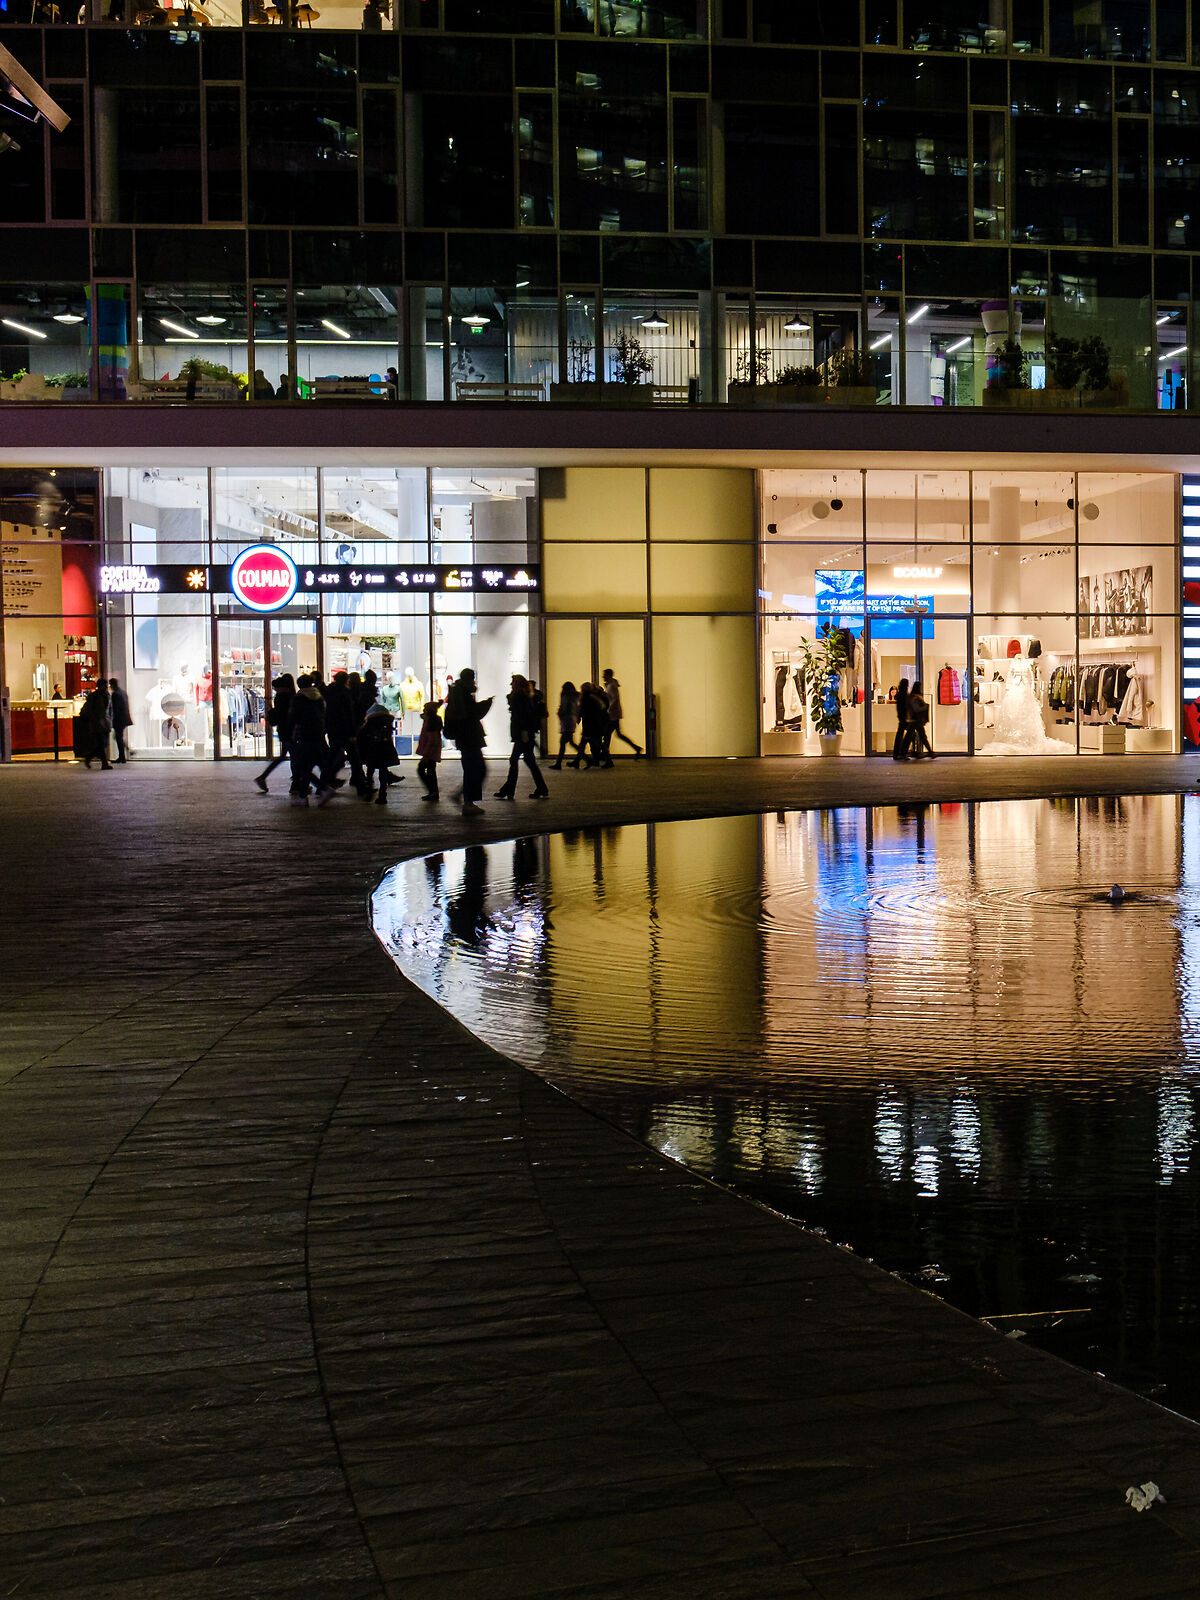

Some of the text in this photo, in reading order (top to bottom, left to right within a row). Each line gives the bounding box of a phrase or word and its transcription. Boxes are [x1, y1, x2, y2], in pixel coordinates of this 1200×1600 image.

[100, 566, 147, 580] CORTINA
[238, 569, 291, 588] COLMAR
[893, 567, 943, 578] ECOALF
[101, 578, 160, 592] D'AMPEZZO
